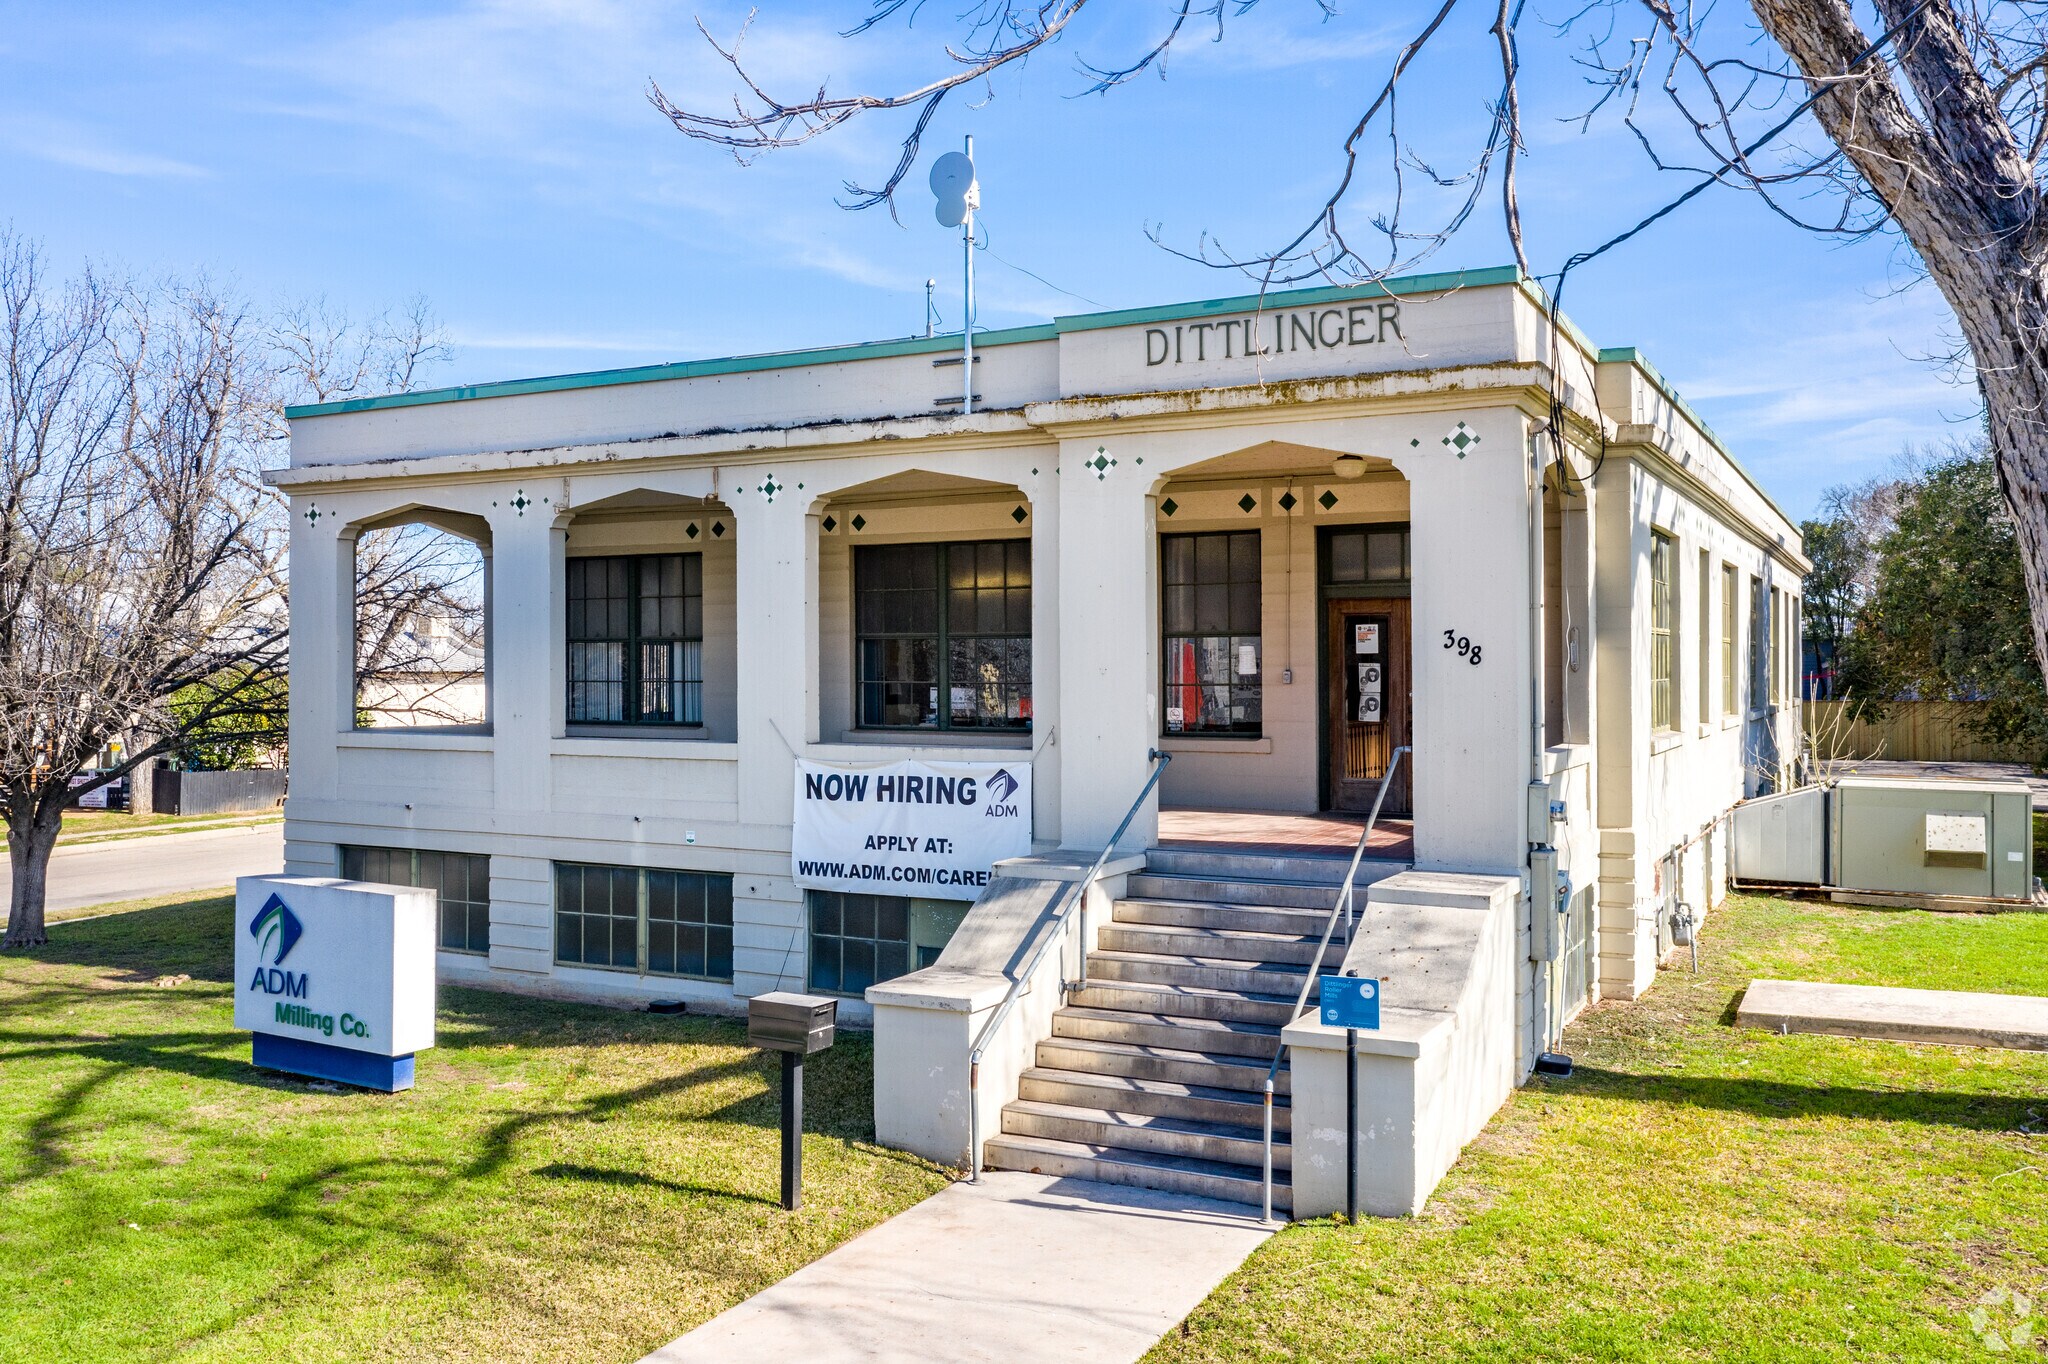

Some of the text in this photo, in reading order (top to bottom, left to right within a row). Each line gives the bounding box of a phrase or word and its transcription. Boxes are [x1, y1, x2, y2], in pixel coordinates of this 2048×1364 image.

[1146, 303, 1405, 366] DITTLINGER
[1443, 629, 1482, 665] 398
[805, 773, 977, 806] NOW HIRING
[985, 804, 1018, 818] ADM
[864, 834, 953, 854] APPLY AT:
[250, 966, 308, 999] ADM
[275, 1002, 370, 1038] Milling Co.
